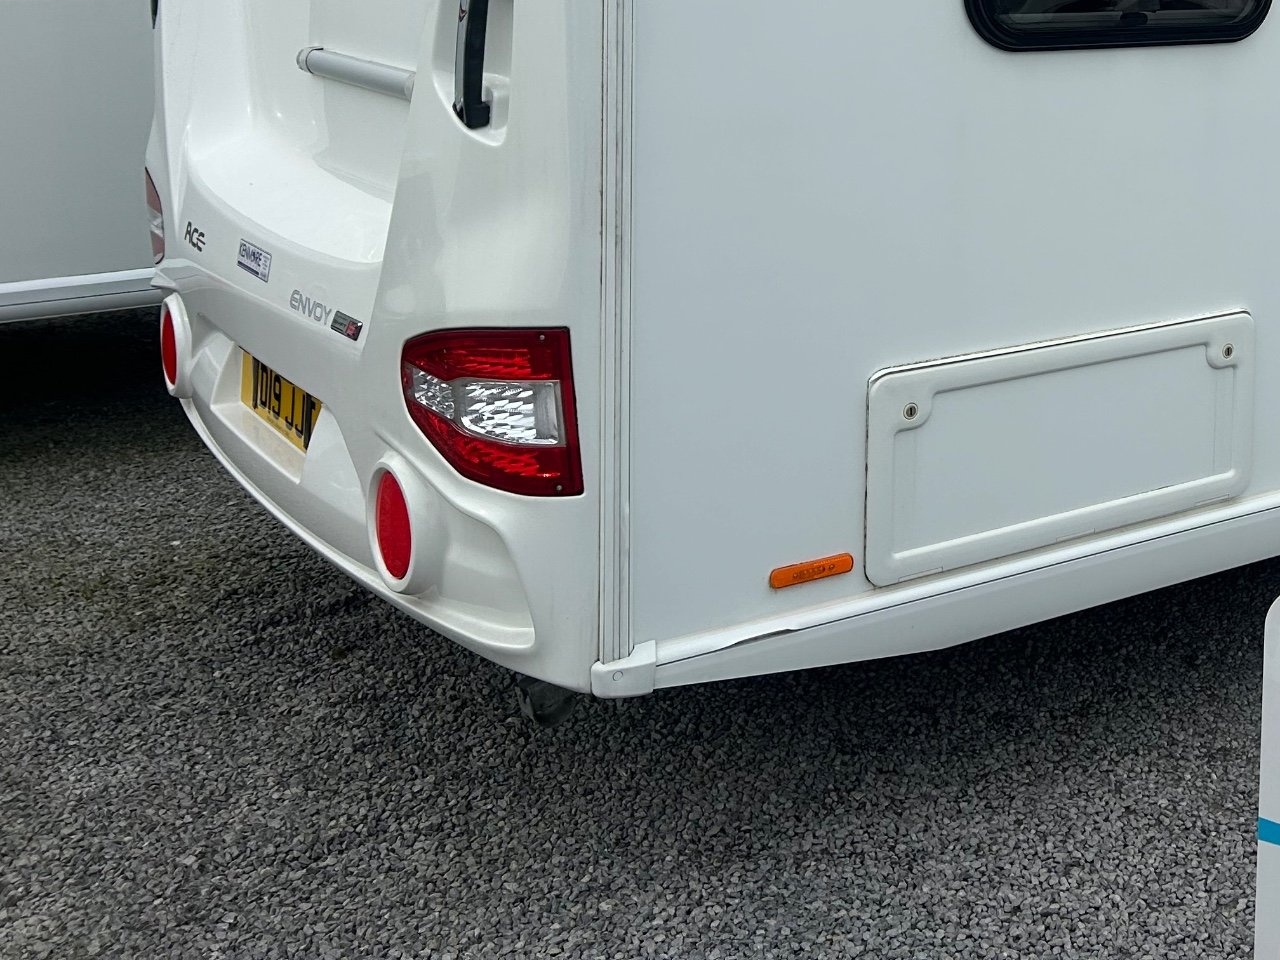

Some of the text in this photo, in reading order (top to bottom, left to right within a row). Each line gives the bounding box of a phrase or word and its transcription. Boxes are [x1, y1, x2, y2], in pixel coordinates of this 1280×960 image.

[184, 221, 206, 253] ACE
[289, 289, 333, 326] ENVOY
[252, 356, 282, 418] D19
